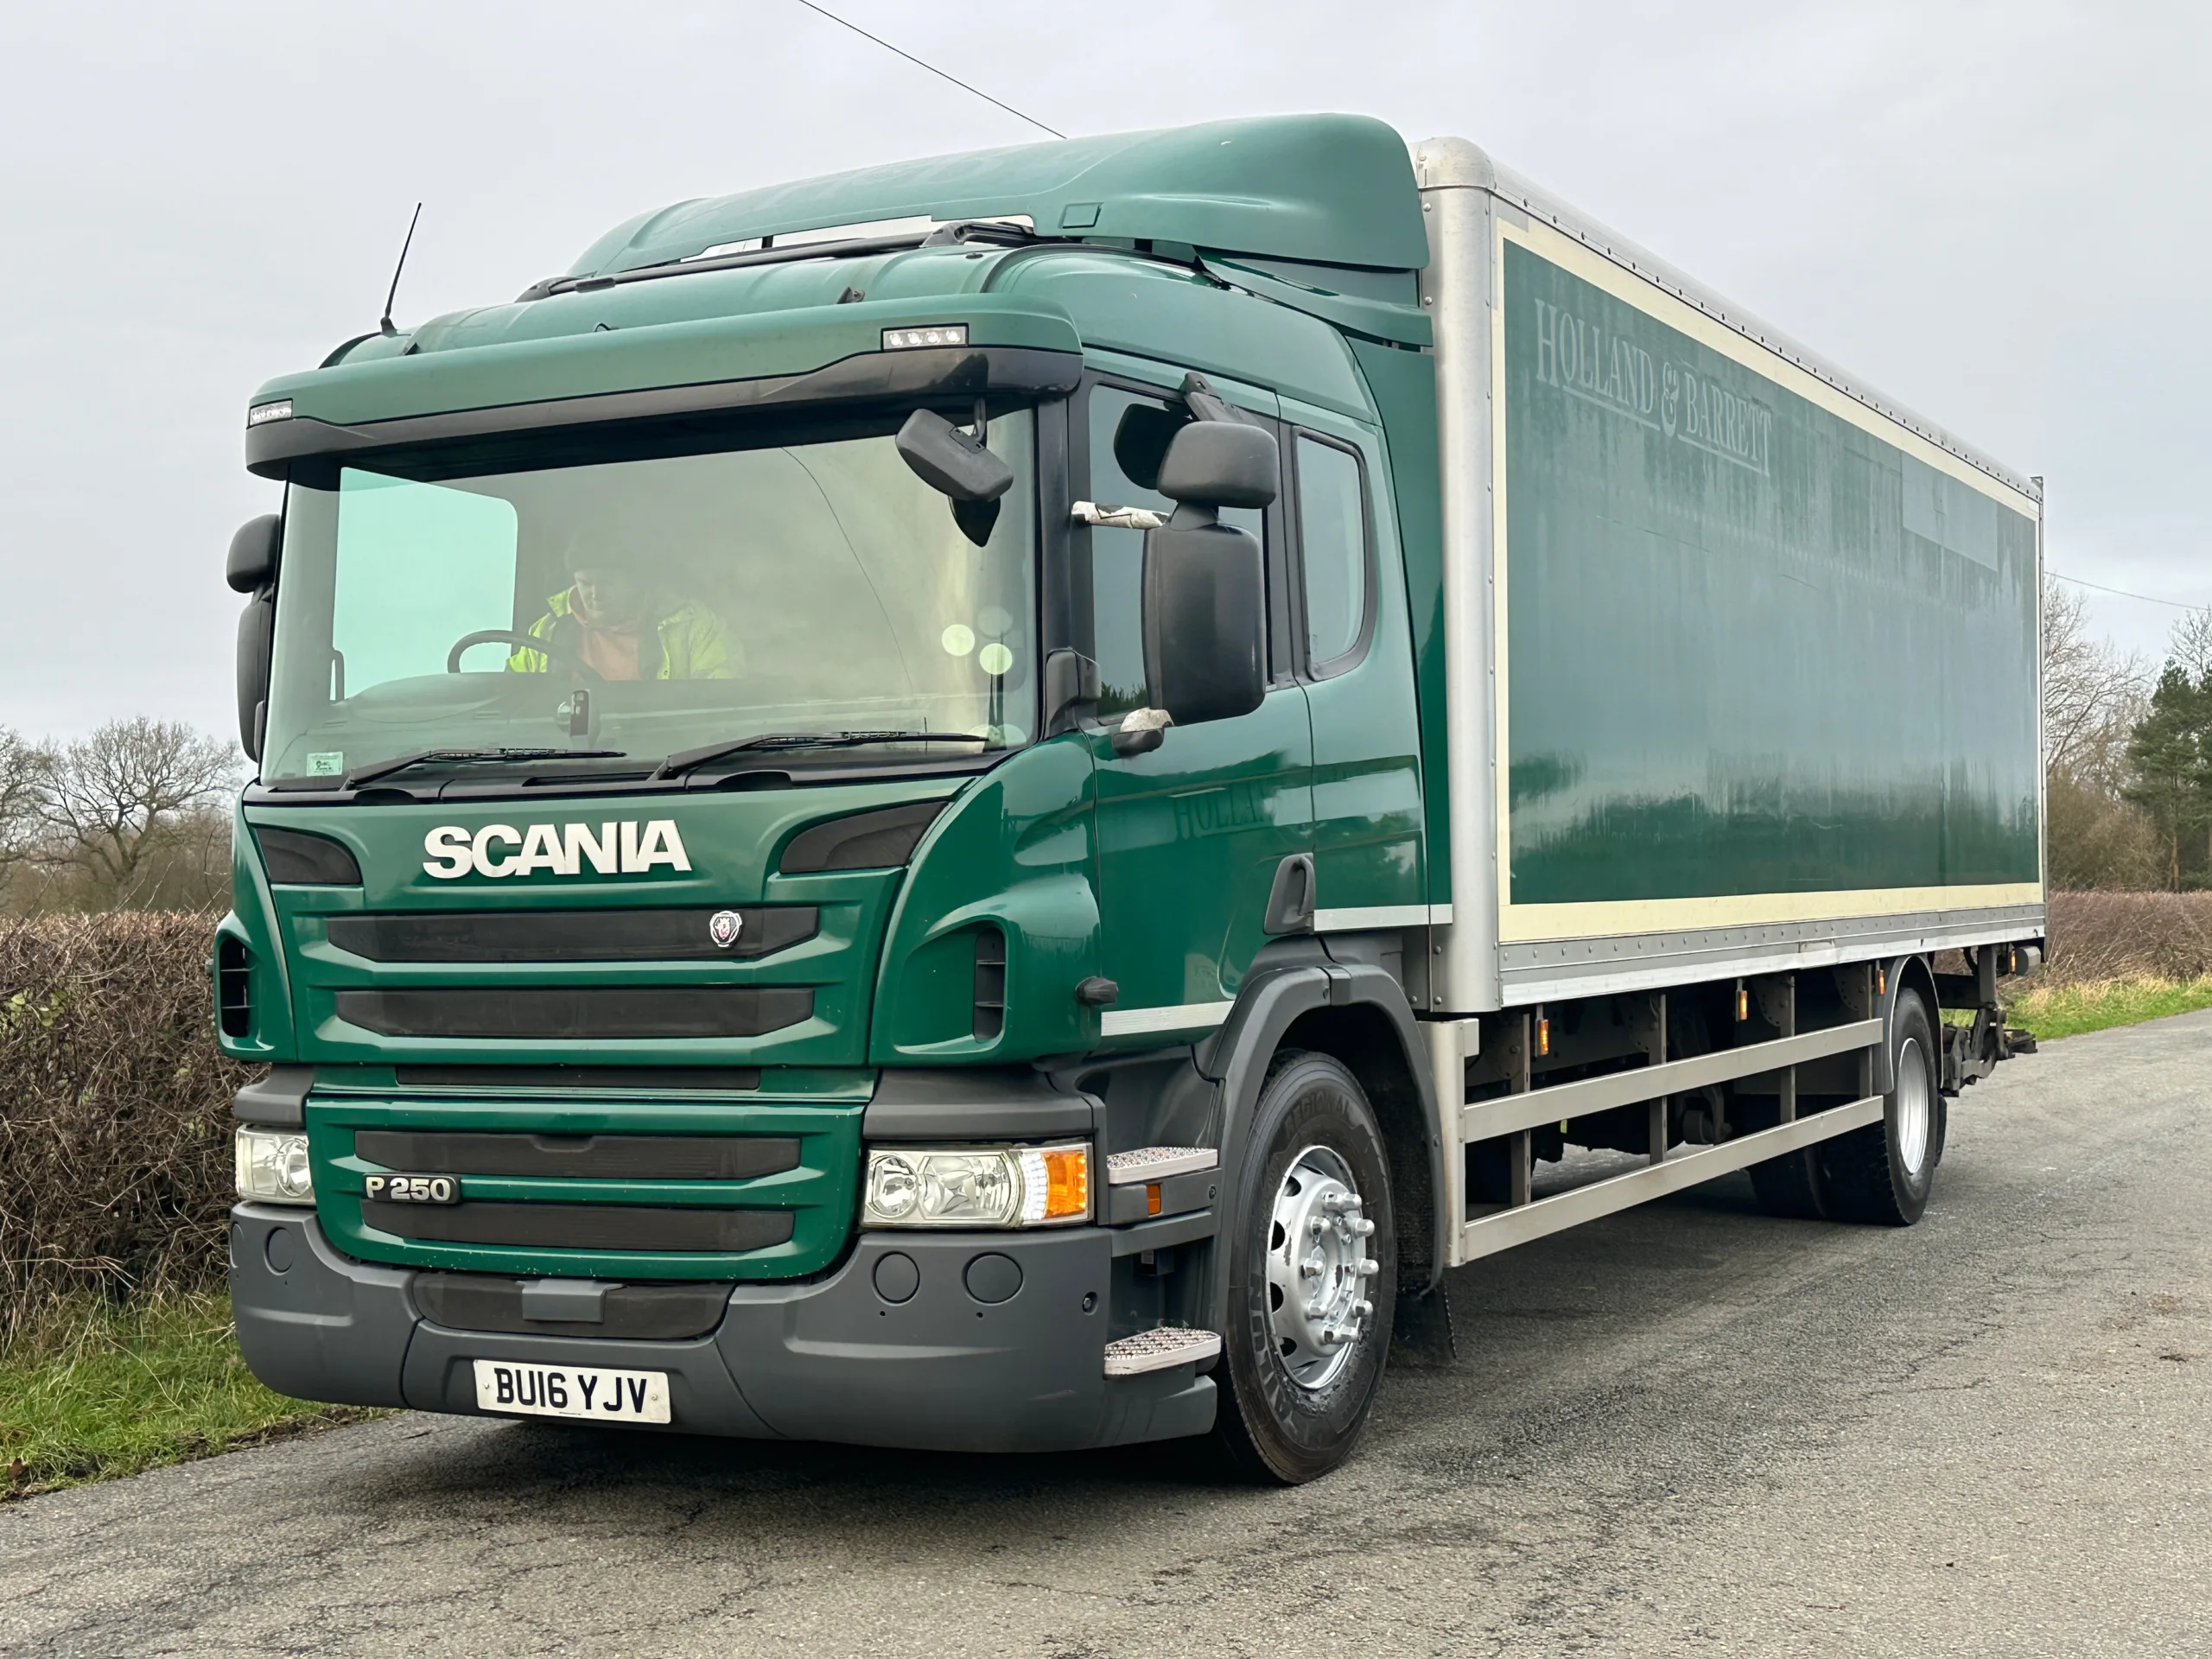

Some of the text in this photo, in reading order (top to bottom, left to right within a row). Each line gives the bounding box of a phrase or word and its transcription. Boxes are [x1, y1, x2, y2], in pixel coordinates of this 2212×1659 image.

[1535, 297, 1772, 477] HOLLAND & BARRETT
[423, 819, 692, 880] SCANIA
[365, 1176, 451, 1202] P 250
[493, 1367, 647, 1414] BU16 YJV
